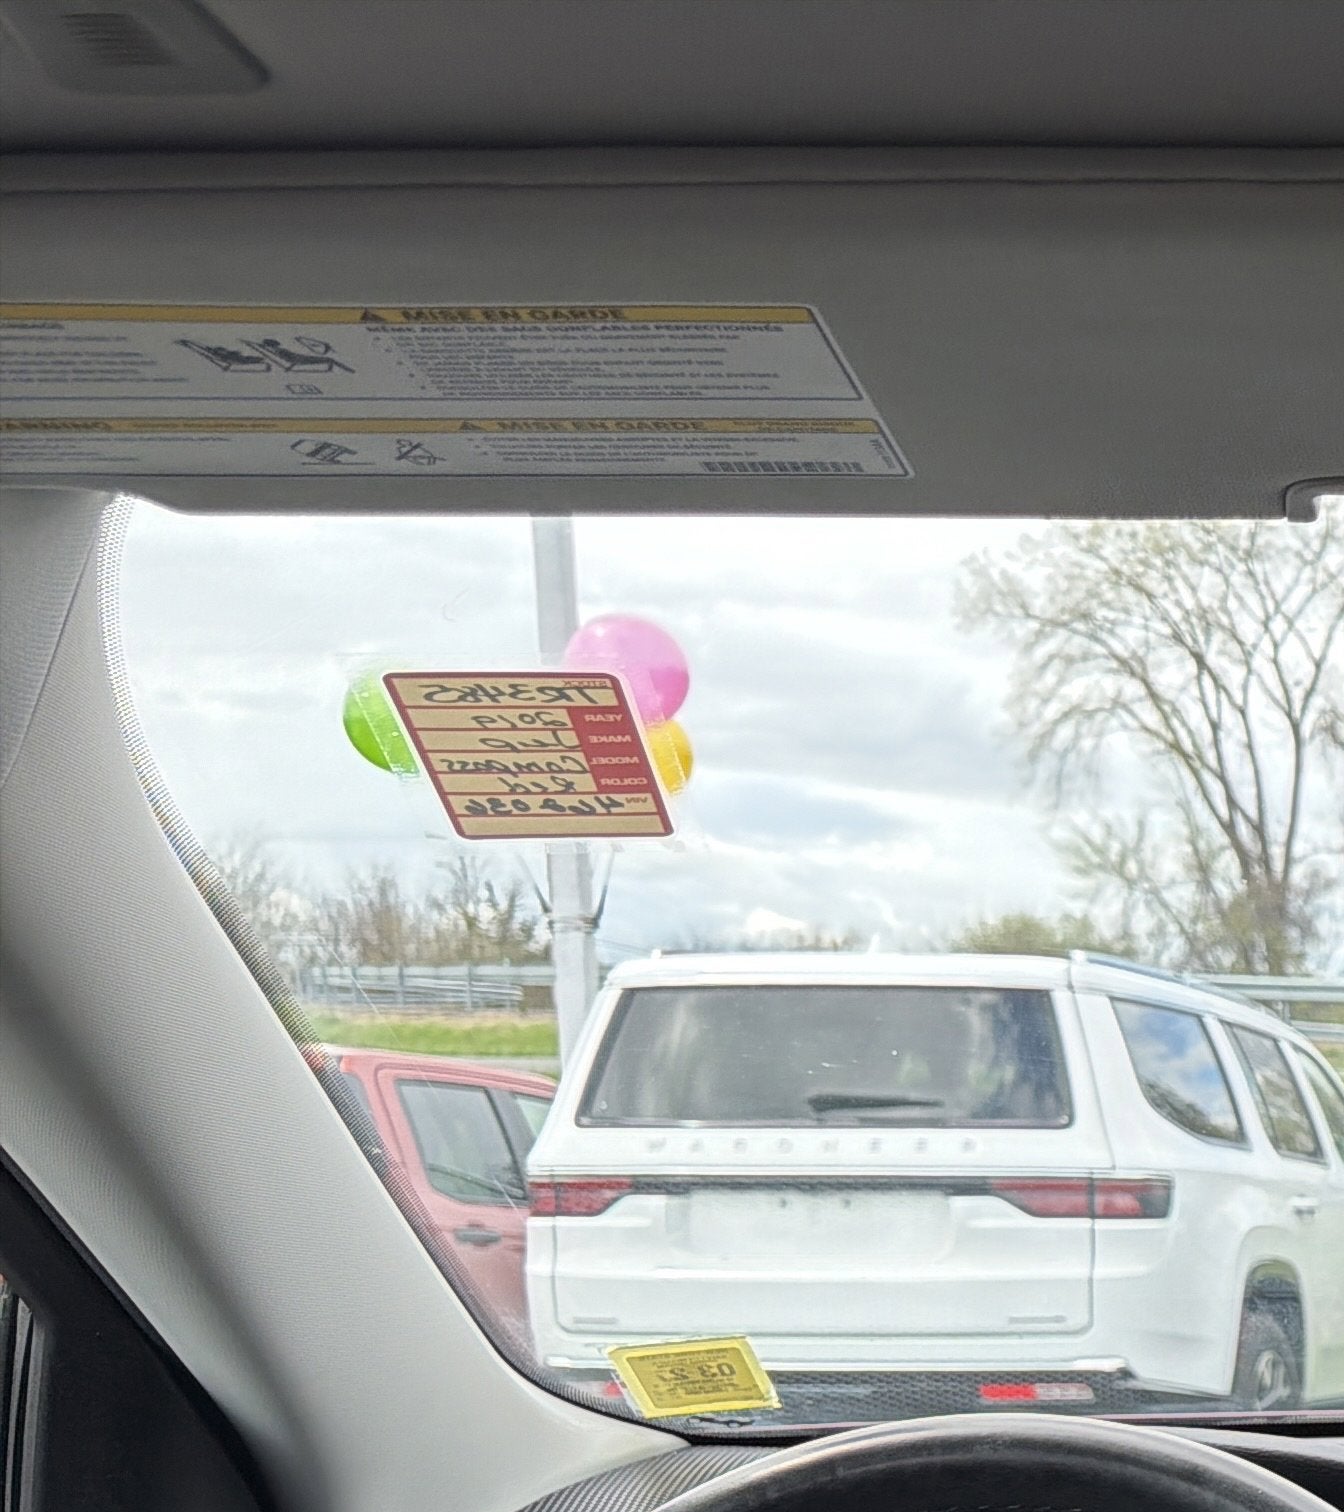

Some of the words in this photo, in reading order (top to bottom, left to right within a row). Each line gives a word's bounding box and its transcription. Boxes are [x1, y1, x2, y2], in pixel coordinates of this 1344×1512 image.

[402, 308, 473, 321] MISE
[481, 308, 521, 321] EN
[530, 307, 626, 320] GARDE
